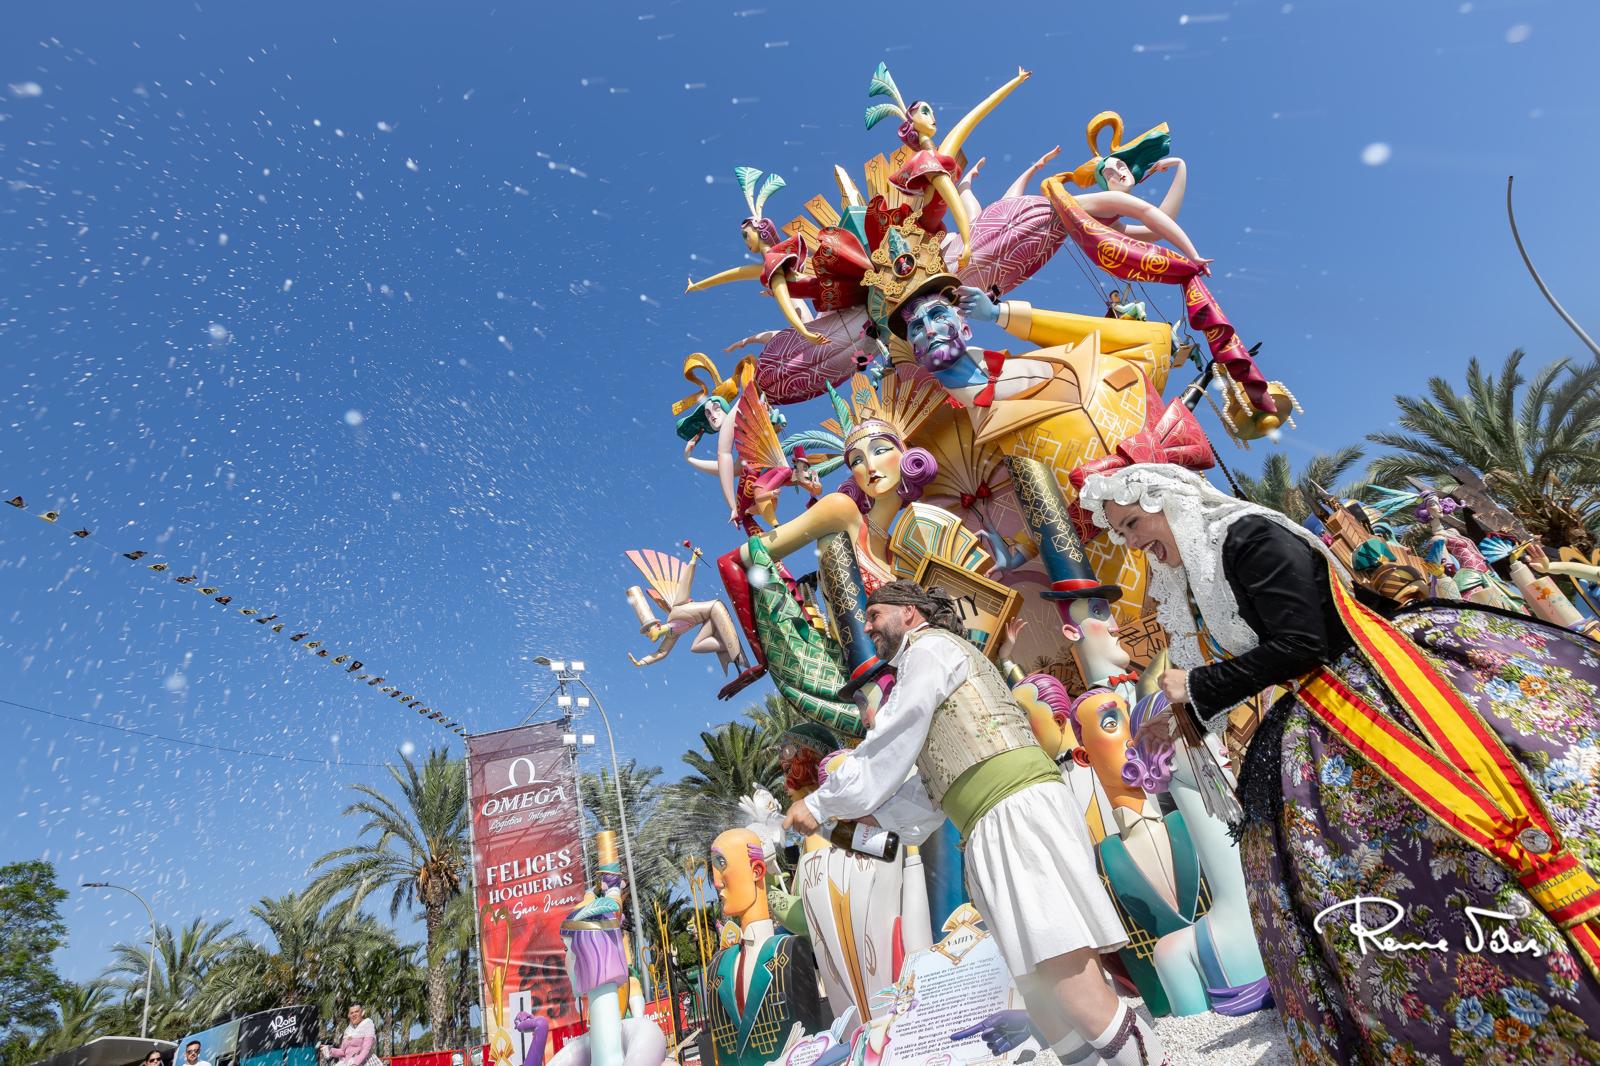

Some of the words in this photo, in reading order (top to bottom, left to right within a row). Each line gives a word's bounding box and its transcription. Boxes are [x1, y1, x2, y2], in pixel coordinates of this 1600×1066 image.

[481, 786, 567, 816] OMEGA
[486, 849, 571, 886] FELICES
[488, 872, 574, 905] HOGUERAS
[512, 900, 539, 920] San
[543, 893, 576, 913] Juan
[275, 1025, 297, 1040] ARENA
